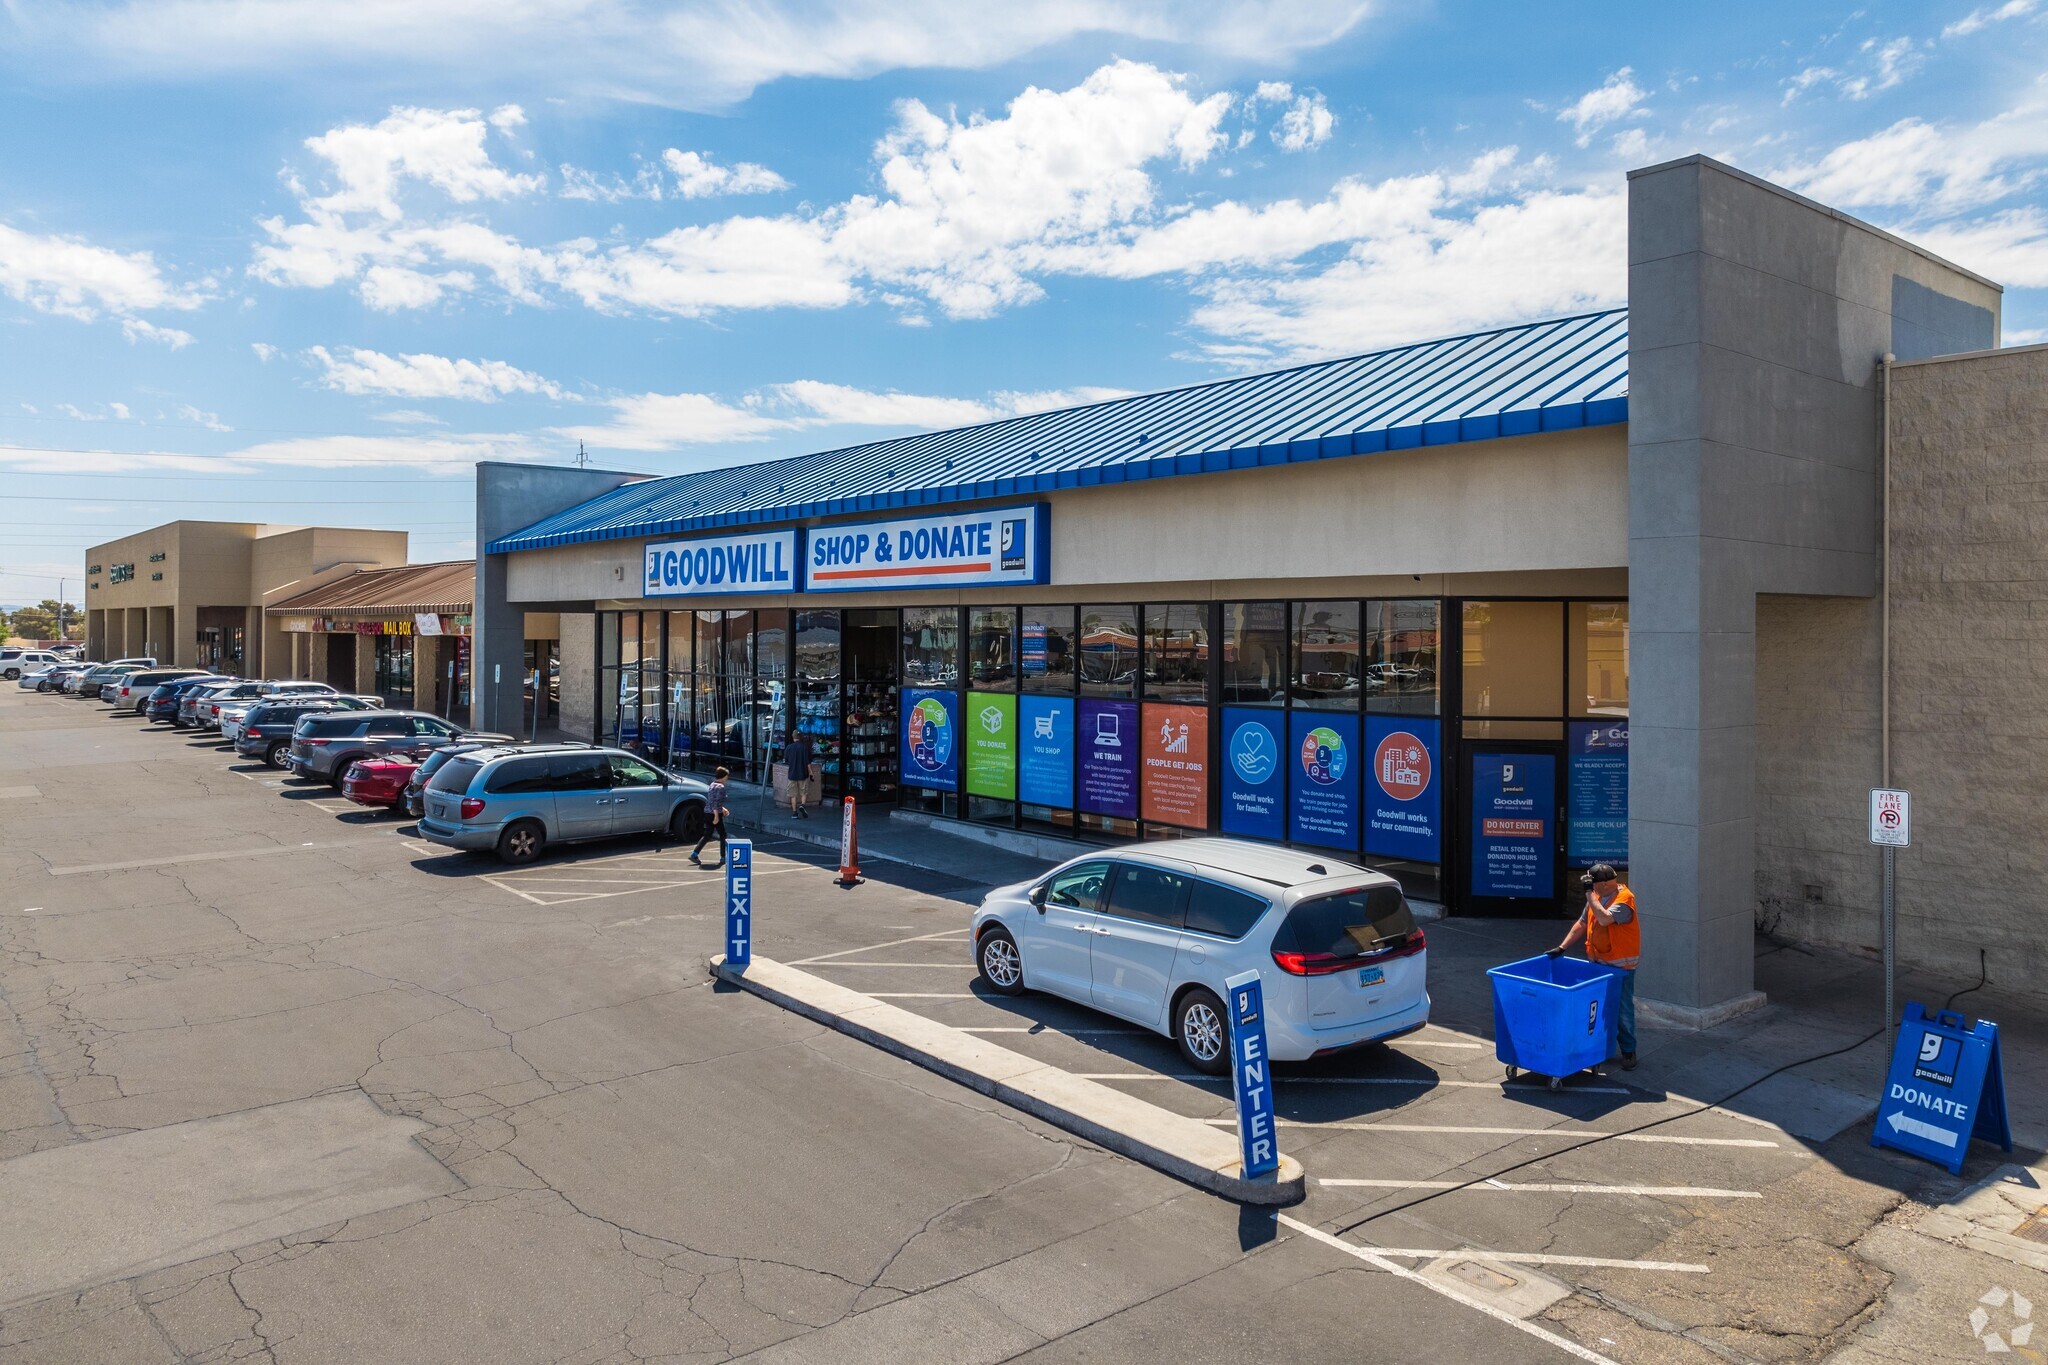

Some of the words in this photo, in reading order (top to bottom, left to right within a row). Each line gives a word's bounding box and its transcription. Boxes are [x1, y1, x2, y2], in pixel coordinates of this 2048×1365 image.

[813, 534, 869, 567] SHOP
[875, 532, 892, 563] &
[899, 522, 992, 560] DONATE
[663, 541, 788, 587] GOODWILL
[1001, 559, 1024, 569] goodwill
[383, 621, 397, 635] MAIL
[399, 621, 411, 635] BOX
[987, 740, 1007, 750] DONATE
[1045, 747, 1061, 755] SHOP
[1093, 752, 1103, 760] WE
[1104, 753, 1122, 761] TRAIN
[1147, 758, 1171, 768] PEOPLE
[1173, 761, 1185, 769] GET
[1186, 763, 1202, 771] JOBS
[1232, 791, 1256, 802] Goodwill
[1257, 794, 1274, 804] works
[1880, 793, 1900, 802] FIRE
[1236, 802, 1245, 811] for
[1245, 803, 1270, 814] families.
[1879, 802, 1901, 811] LANE
[1298, 815, 1309, 823] Your
[1310, 817, 1331, 825] Goodwill
[1332, 819, 1348, 828] works
[1377, 808, 1406, 820] Goodwill
[1407, 813, 1428, 823] works
[1318, 825, 1346, 835] community.
[1371, 819, 1381, 829] for
[1382, 822, 1393, 830] our
[1394, 821, 1434, 837] community.
[1499, 821, 1514, 829] NOT
[1515, 822, 1539, 830] ENTER
[731, 877, 748, 957] EXIT
[1915, 1068, 1952, 1084] goodwill
[1243, 1035, 1271, 1165] ENTER
[1890, 1083, 1968, 1121] DONATE
